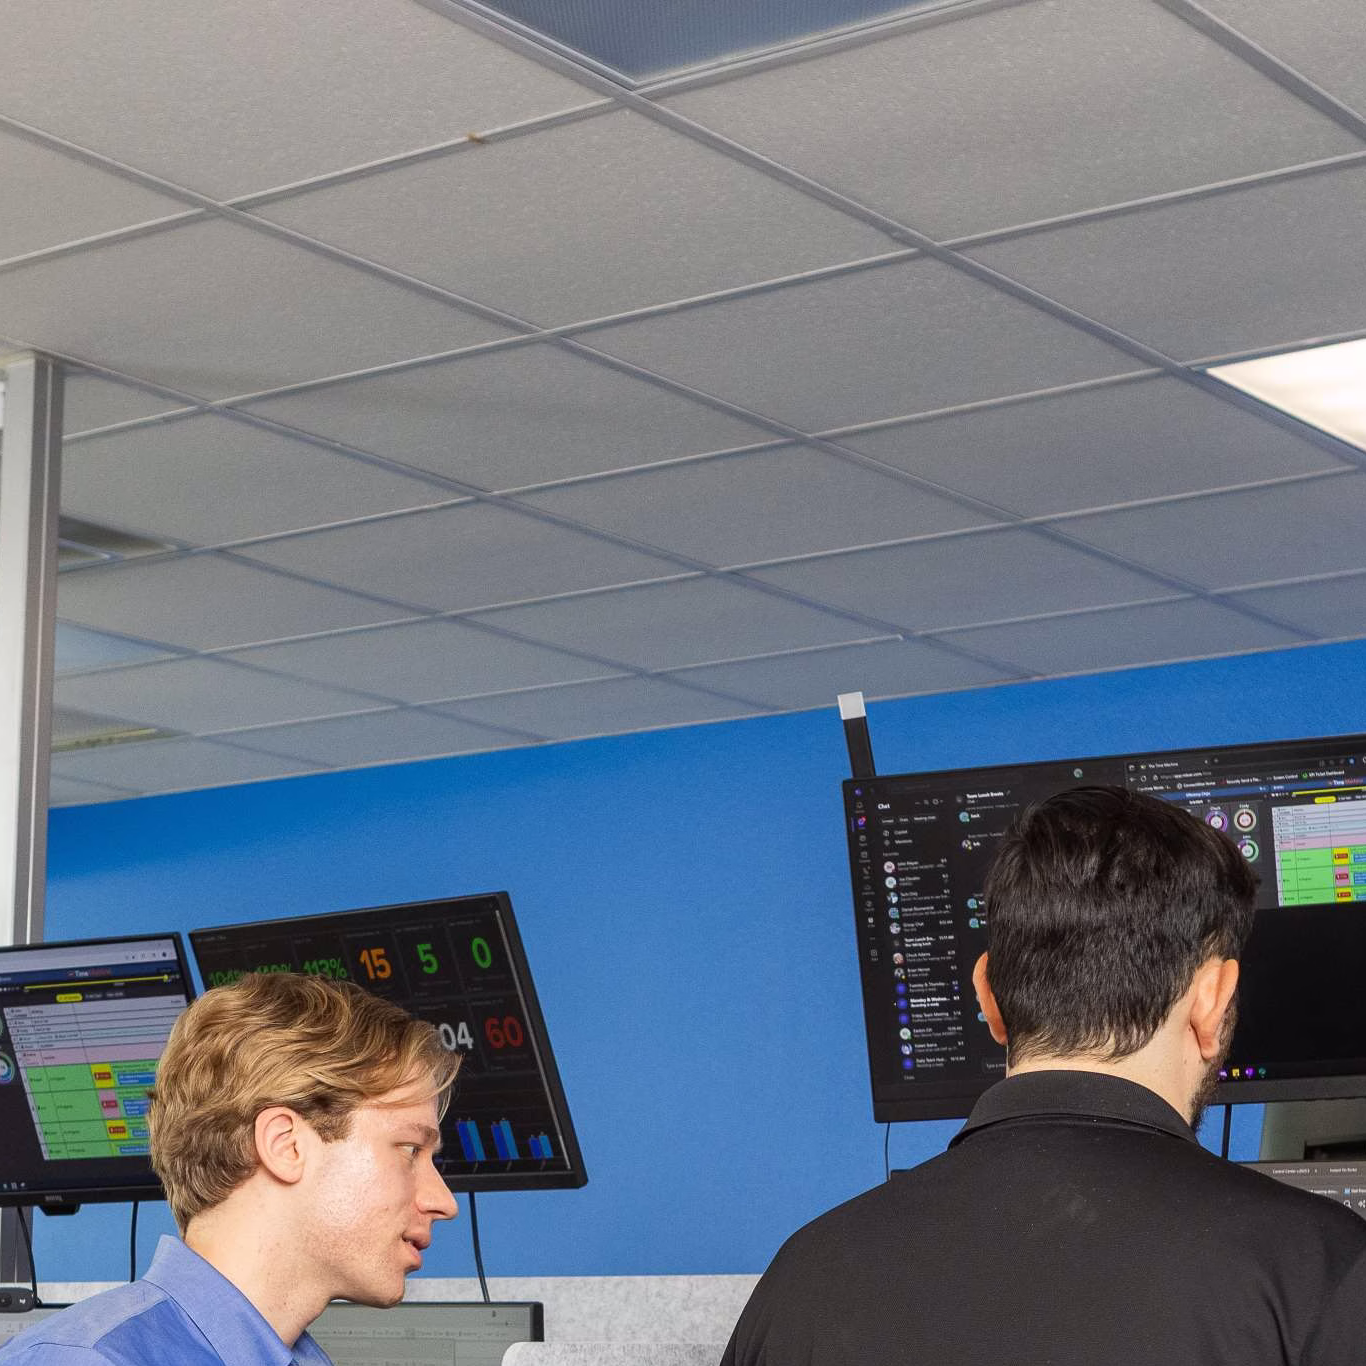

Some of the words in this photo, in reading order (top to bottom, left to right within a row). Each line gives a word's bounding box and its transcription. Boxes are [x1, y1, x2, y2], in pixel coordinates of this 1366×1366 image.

[359, 948, 392, 980] 15
[417, 943, 439, 974] 5
[471, 938, 493, 969] 0
[438, 1021, 474, 1051] 04
[485, 1016, 524, 1049] 60
